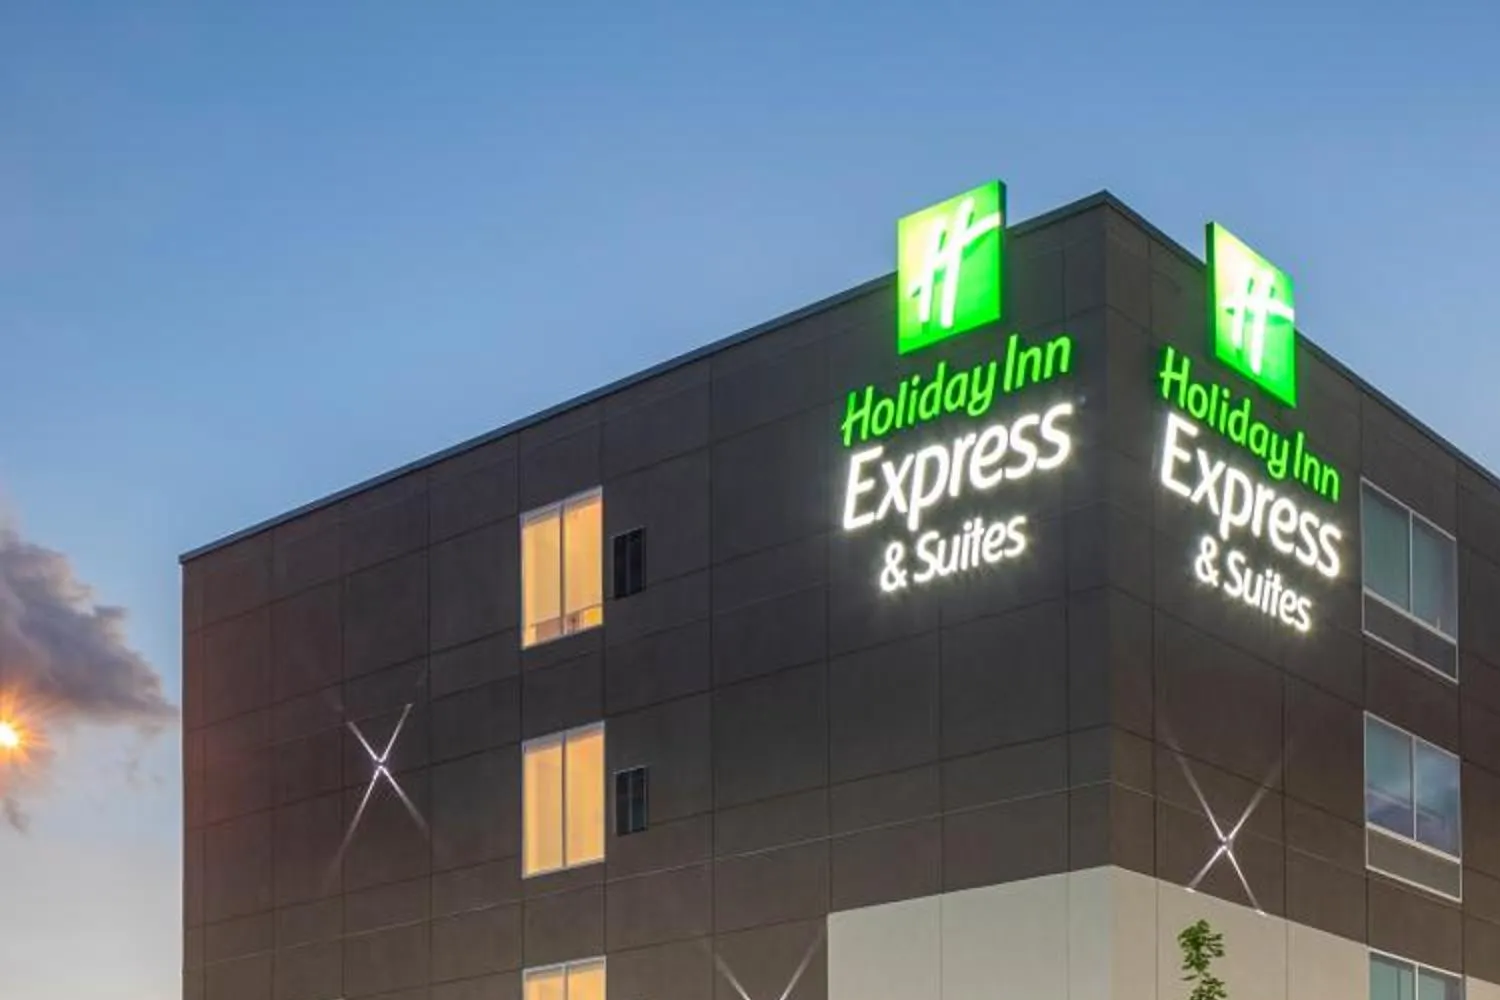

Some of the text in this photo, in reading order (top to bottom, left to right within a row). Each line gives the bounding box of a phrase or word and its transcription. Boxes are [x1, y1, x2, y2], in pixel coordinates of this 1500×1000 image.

[841, 333, 1071, 447] Holiday Inn
[1159, 346, 1341, 503] Holiday Inn
[843, 402, 1074, 532] Express
[1160, 411, 1342, 579] Express
[879, 515, 1027, 593] & Suites
[1194, 534, 1313, 633] & Suites
